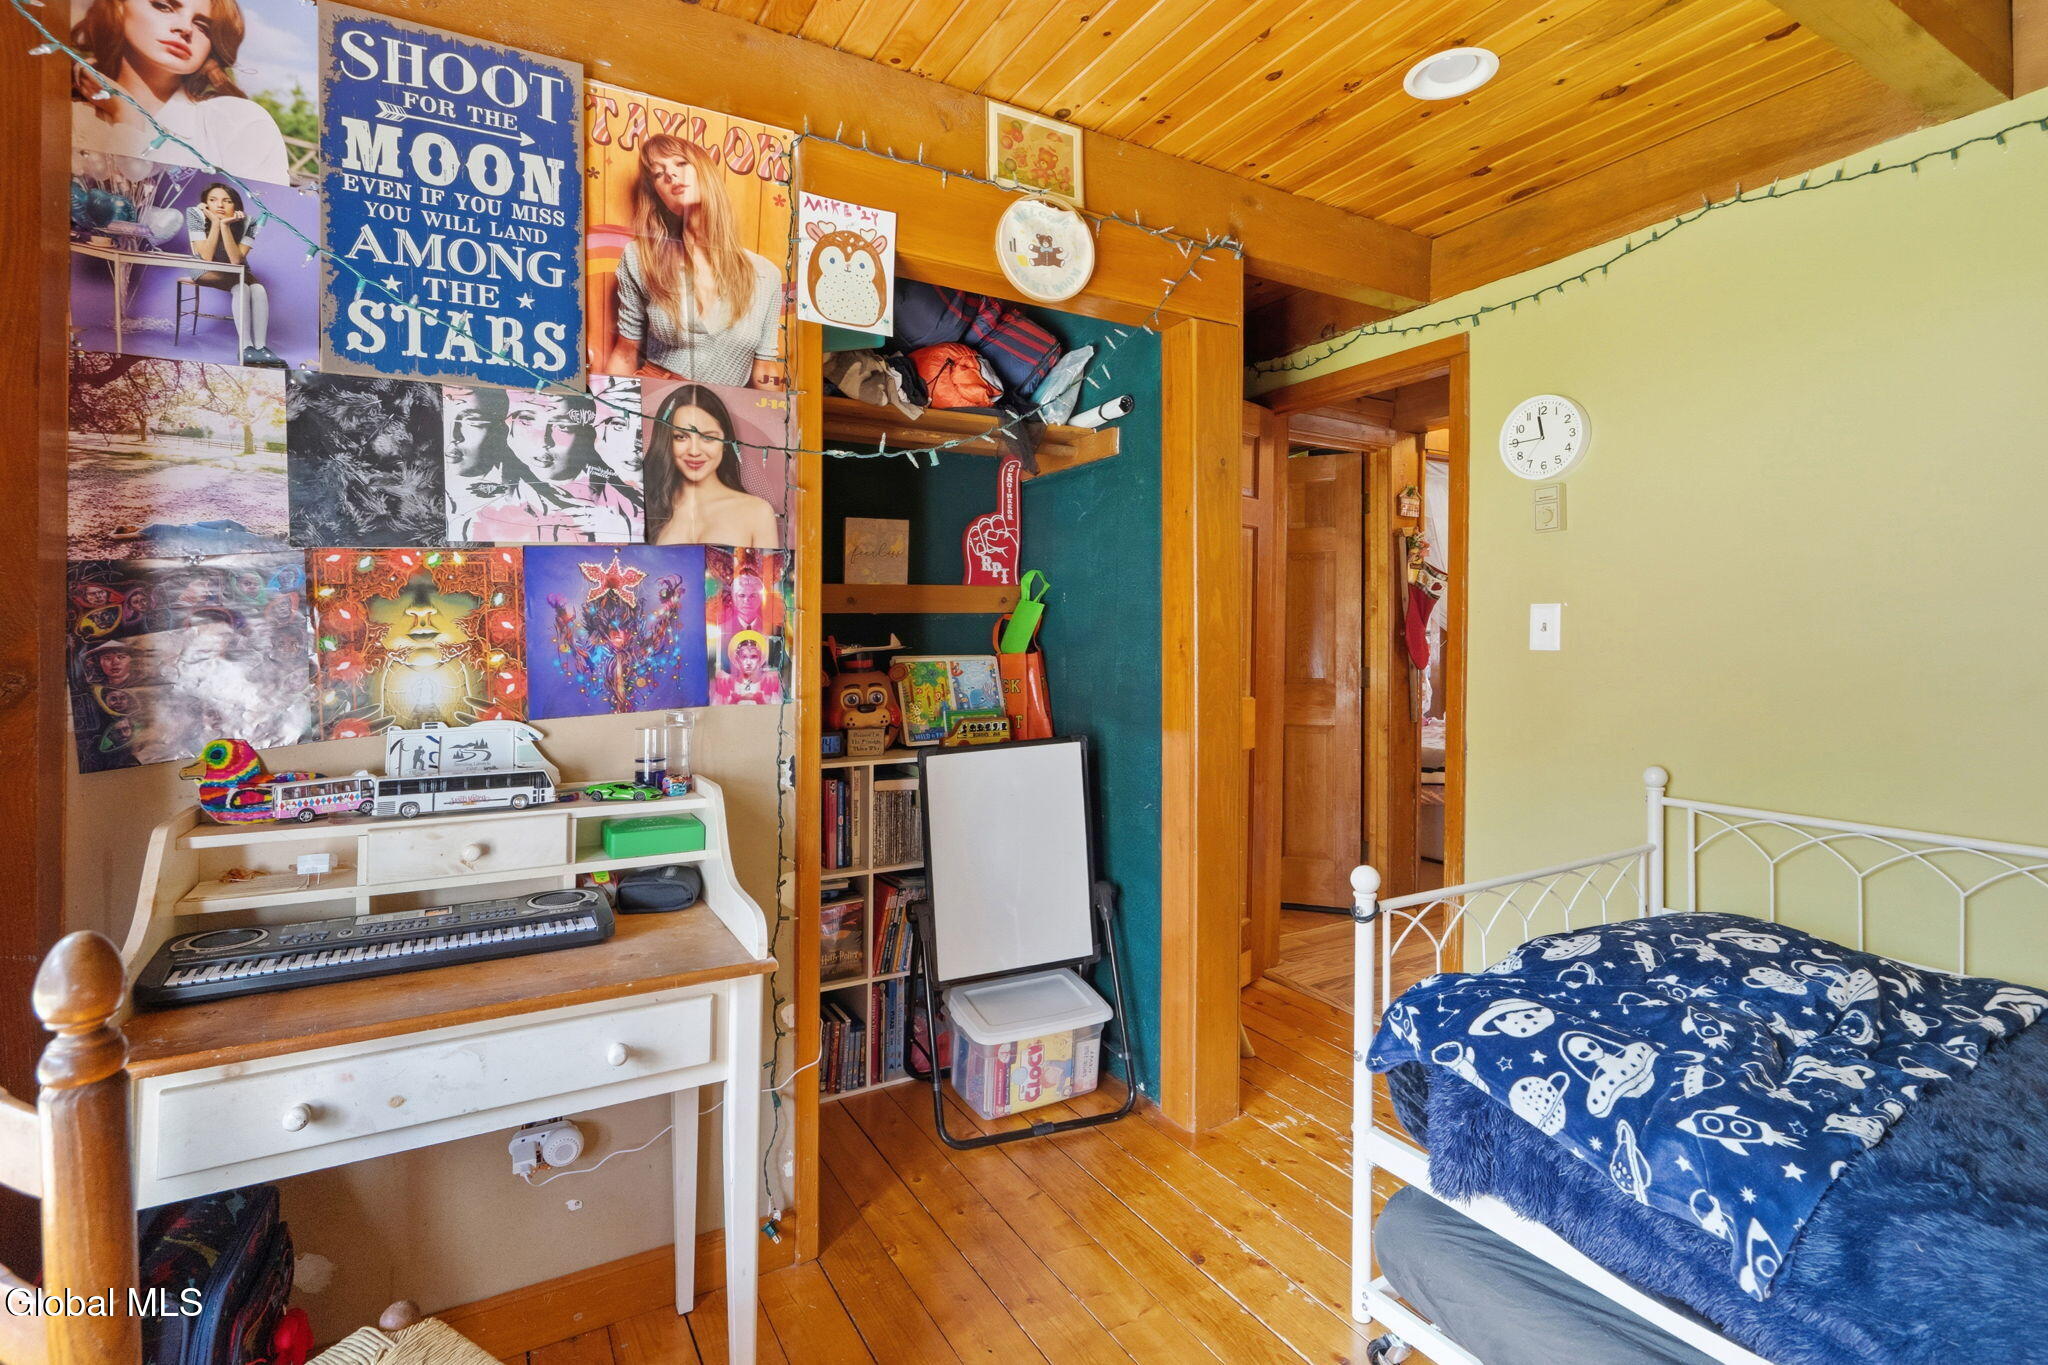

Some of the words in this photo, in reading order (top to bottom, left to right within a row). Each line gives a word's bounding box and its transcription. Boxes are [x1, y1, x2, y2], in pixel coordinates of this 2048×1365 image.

[340, 30, 564, 124] SHOOT
[402, 91, 456, 119] FOR
[466, 105, 518, 131] THE
[584, 93, 790, 183] TAYLOR
[341, 116, 565, 206] MOON
[342, 173, 412, 200] EVEN
[420, 187, 445, 206] IF
[454, 193, 502, 216] YOU
[511, 203, 566, 227] MISS
[363, 200, 412, 223] YOU
[421, 210, 481, 235] WILL
[490, 221, 548, 245] LAND
[344, 223, 566, 288] AMONG
[422, 277, 500, 309] THE
[346, 299, 567, 372] STARS
[1538, 405, 1547, 415] 12
[1555, 406, 1558, 415] 1
[1526, 412, 1531, 421] 11
[1564, 414, 1571, 424] 2
[1516, 424, 1525, 434] 10
[1569, 427, 1576, 437] 3
[1512, 438, 1519, 448] 9
[1564, 443, 1572, 452] 4
[1517, 451, 1524, 460] 8
[1554, 455, 1562, 464] 5
[1527, 459, 1533, 469] 7
[1540, 461, 1547, 470] 6
[981, 555, 1010, 585] RPI
